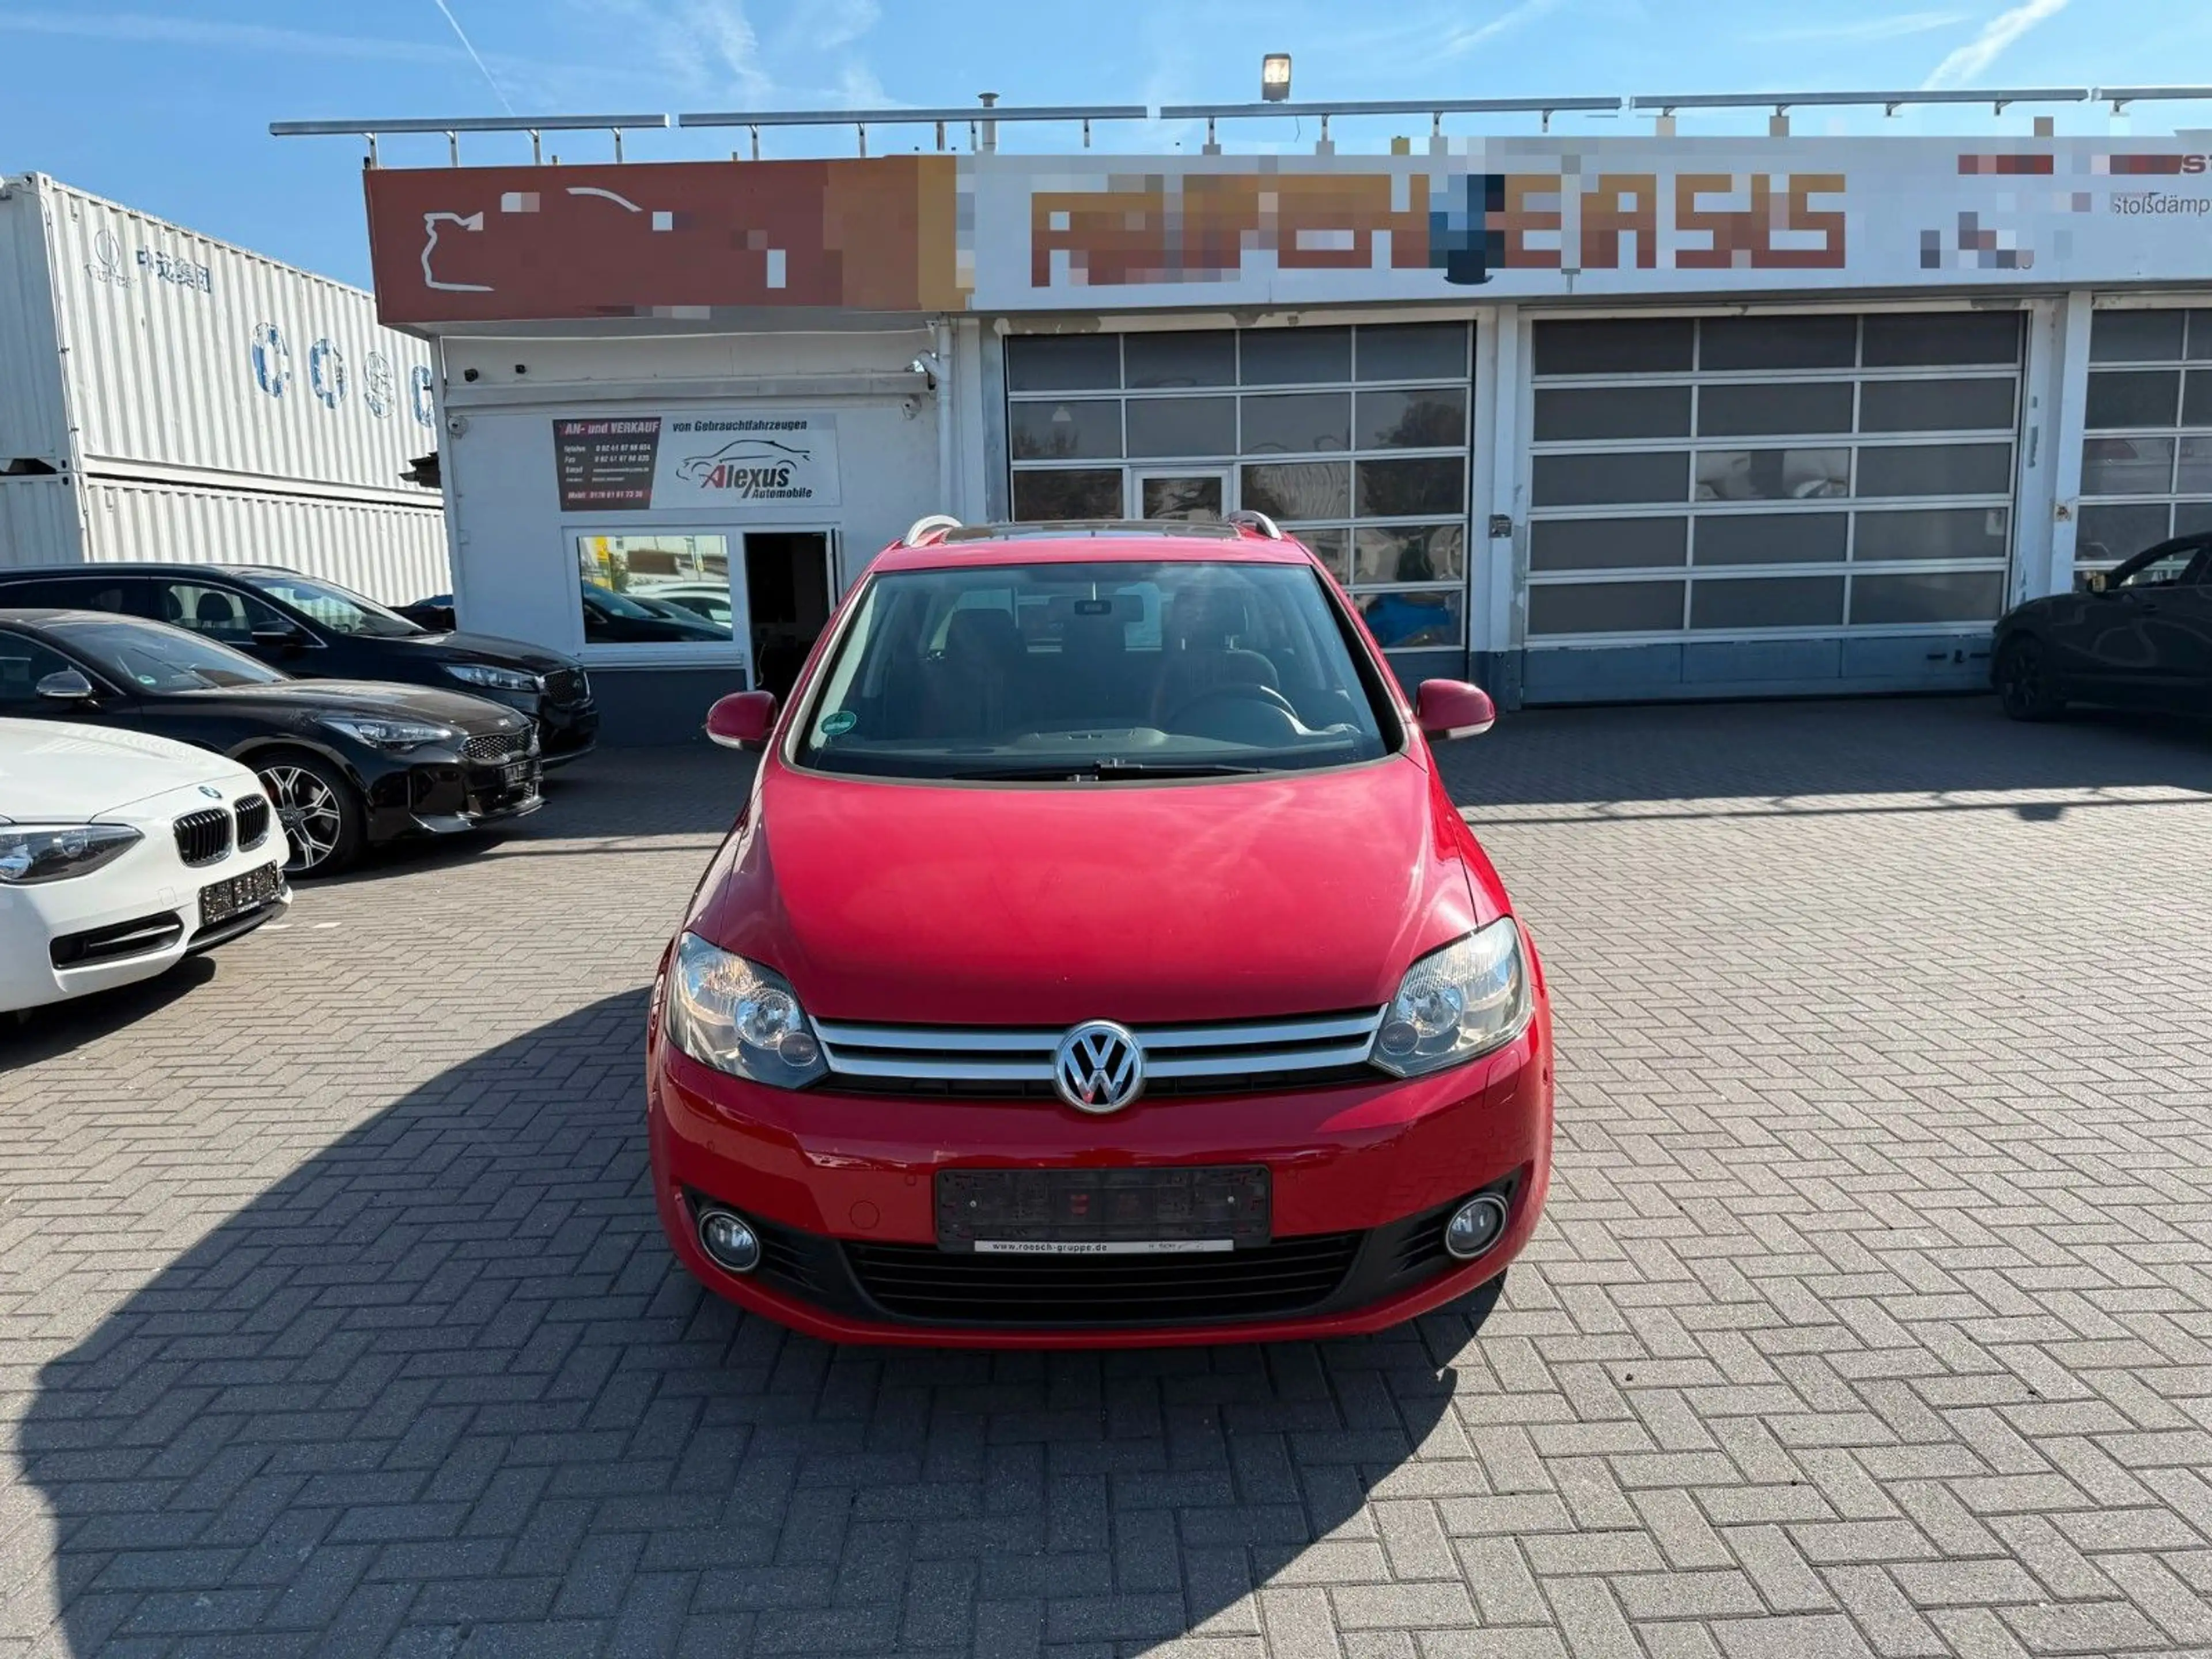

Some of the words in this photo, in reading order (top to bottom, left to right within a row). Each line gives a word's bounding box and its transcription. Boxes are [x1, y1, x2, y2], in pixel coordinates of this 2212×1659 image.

[2113, 192, 2211, 217] Stoßdämp
[565, 423, 585, 434] AN-
[588, 423, 608, 434] und
[611, 422, 658, 433] VERKAUF
[673, 423, 691, 432] von
[695, 421, 807, 431] Gebrauchtfahrzeugen
[699, 464, 790, 498] Alexus
[752, 488, 813, 498] Automobile
